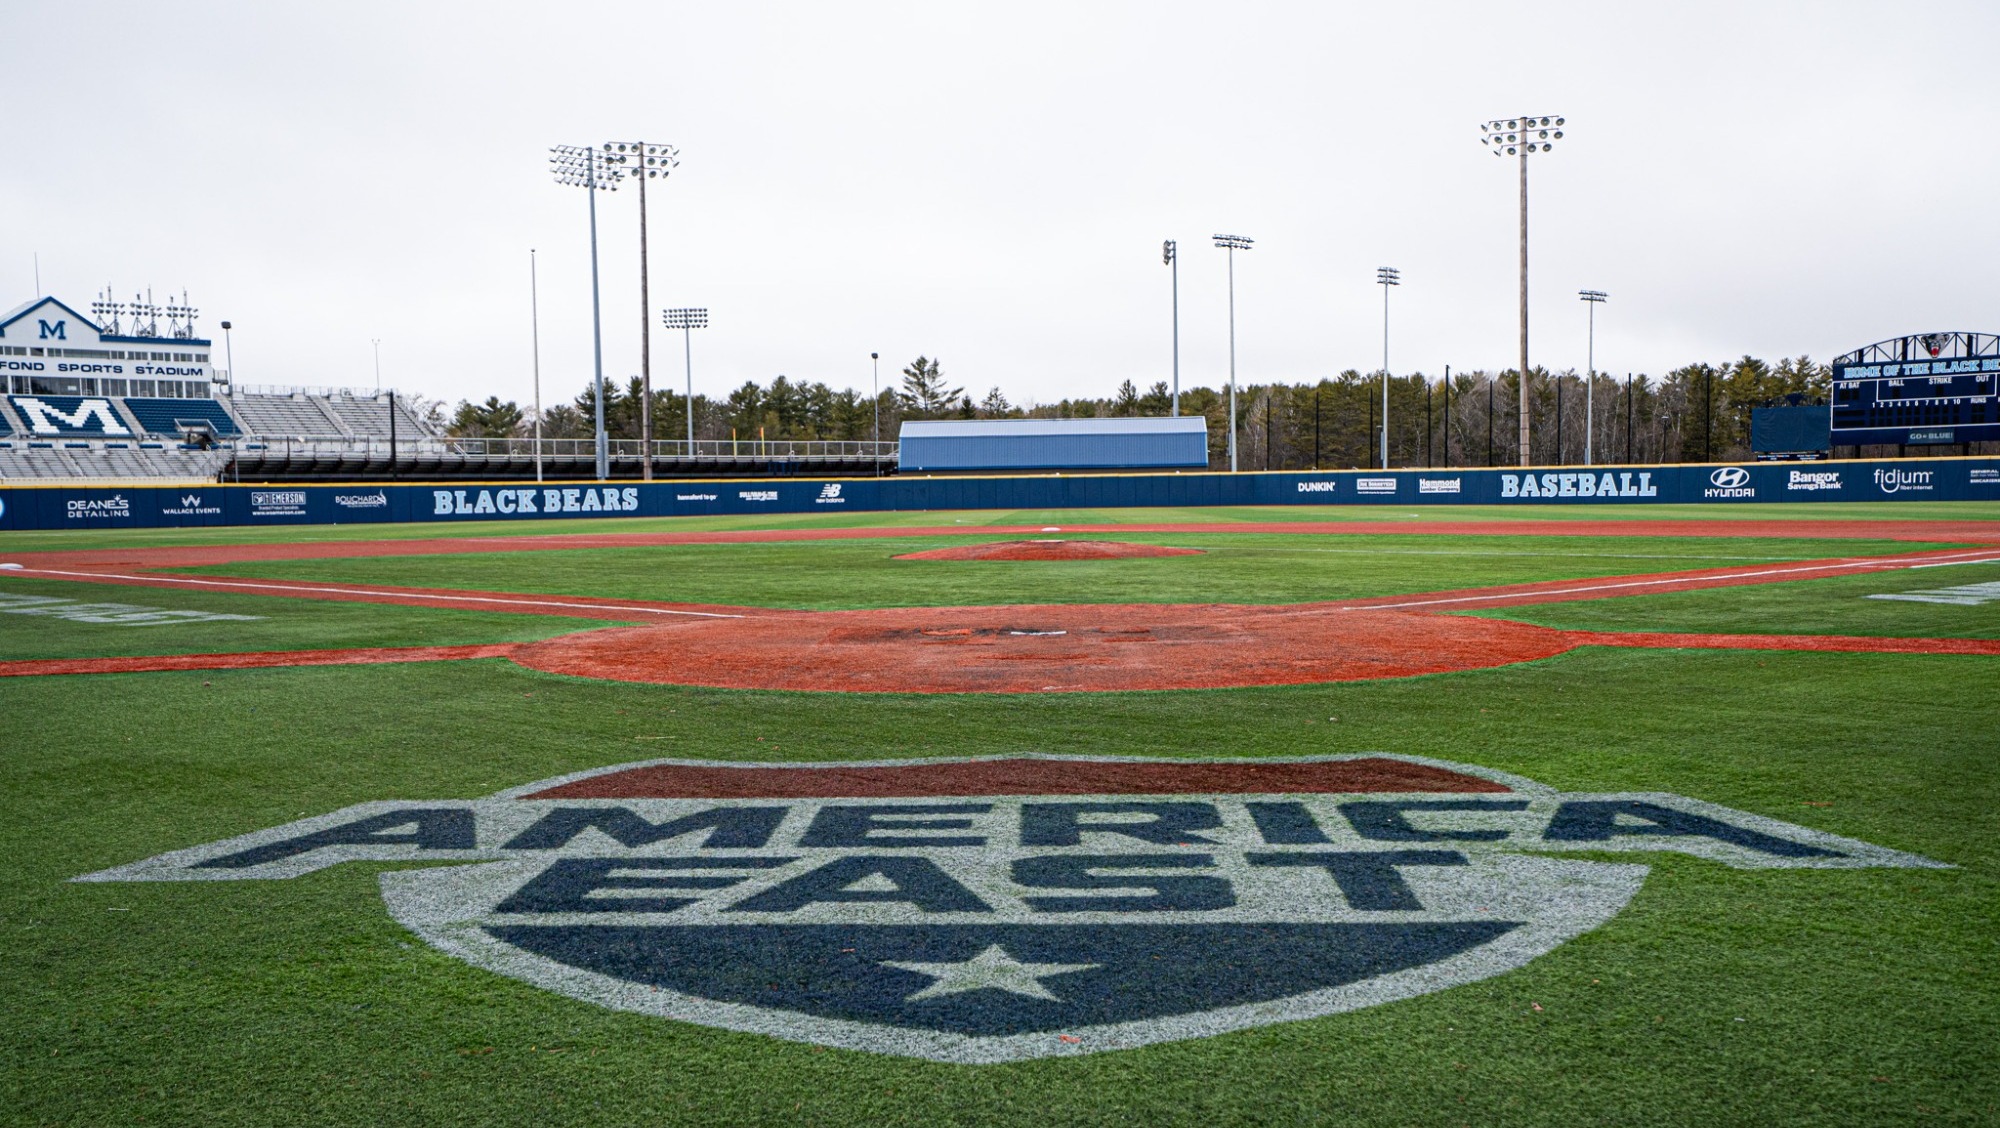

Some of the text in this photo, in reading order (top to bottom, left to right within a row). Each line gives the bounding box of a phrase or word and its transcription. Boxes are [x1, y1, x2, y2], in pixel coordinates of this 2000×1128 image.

[39, 320, 66, 340] M
[58, 363, 123, 374] SPORTS
[136, 366, 203, 376] STADIUM
[1844, 366, 1881, 379] HOME
[1883, 365, 1900, 377] OF
[1902, 363, 1930, 375] THE
[1932, 360, 1980, 374] BLACK
[1929, 377, 1952, 385] STRIKE
[1420, 478, 1460, 487] Hammond
[1790, 471, 1839, 484] Bangor
[1502, 473, 1657, 497] BASEBALL
[1788, 482, 1818, 490] Savings
[272, 493, 304, 504] EMERSON
[336, 495, 378, 503] BOUCHARD
[1705, 488, 1754, 497] HYUNDAI
[434, 488, 638, 514] BLACK BEARS
[68, 510, 129, 518] DETAILING
[189, 800, 1852, 869] AMERICA
[491, 850, 1469, 914] EAST
